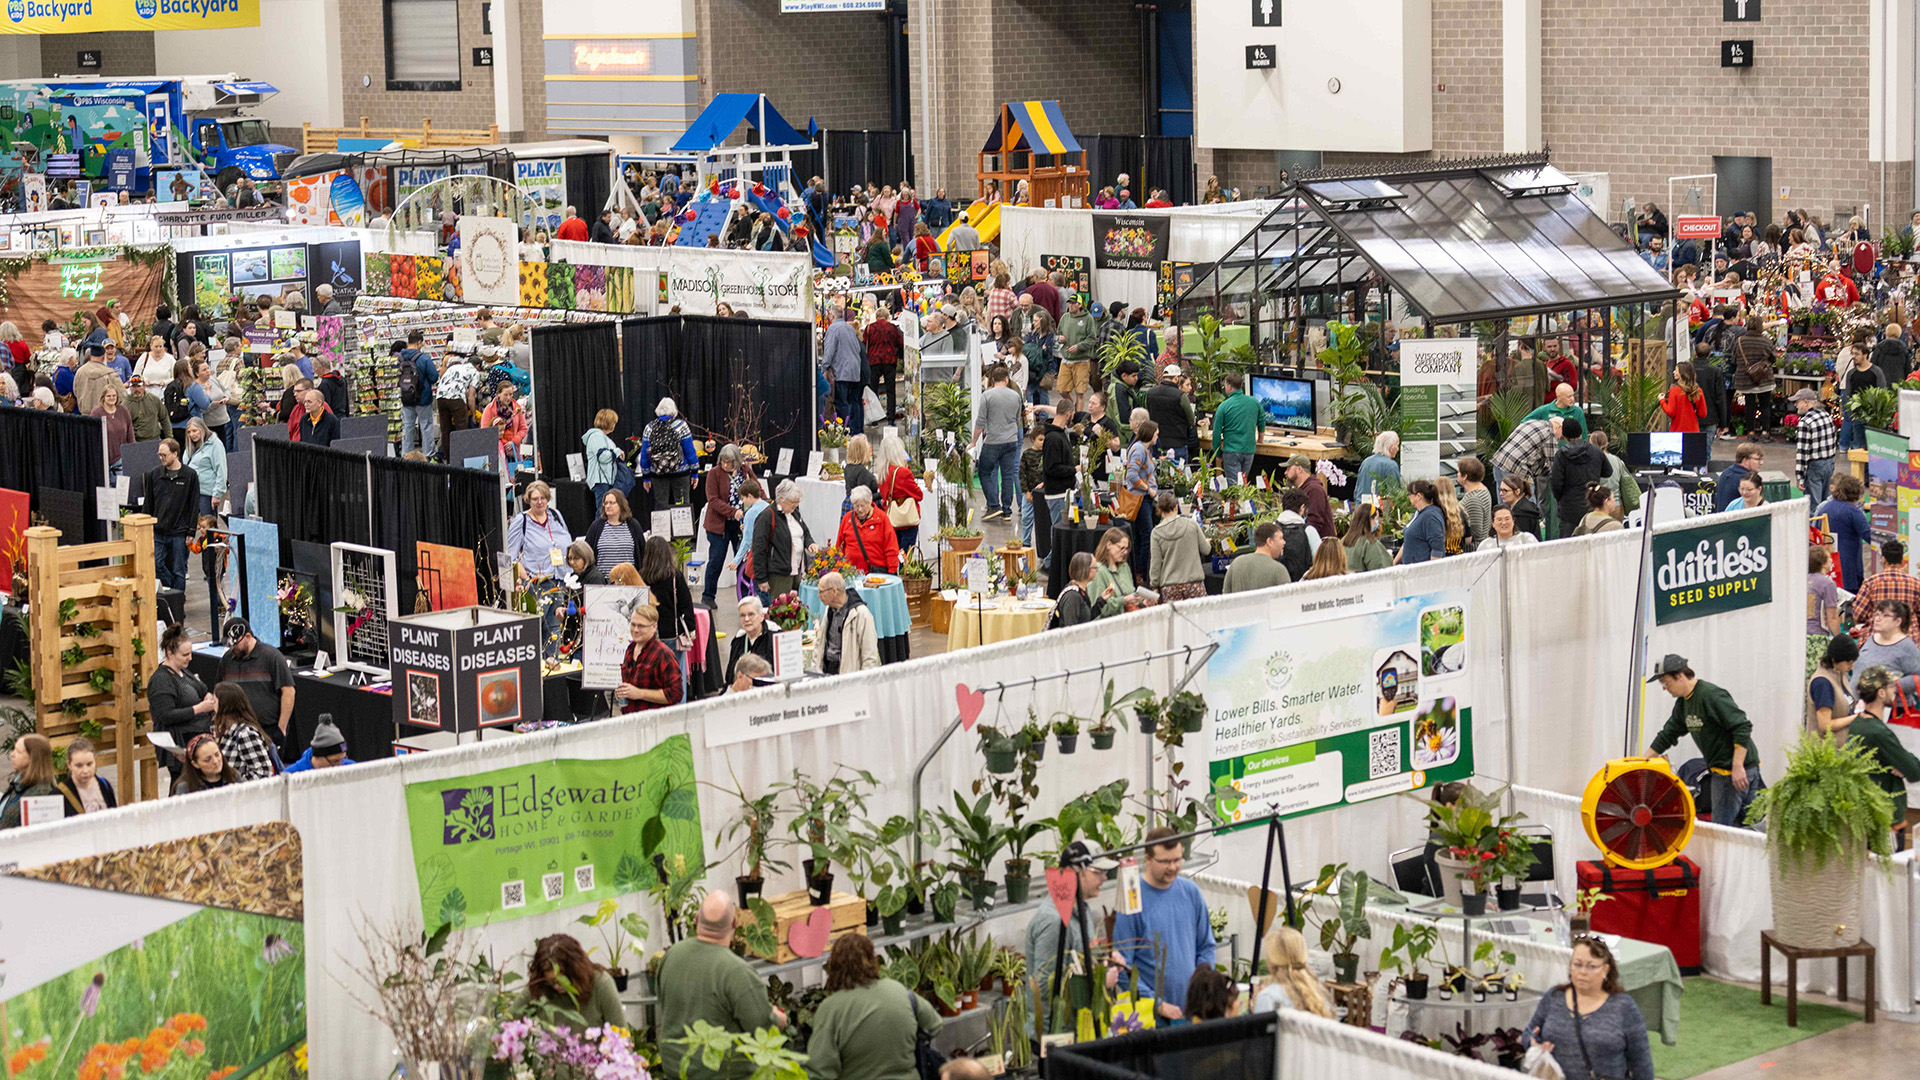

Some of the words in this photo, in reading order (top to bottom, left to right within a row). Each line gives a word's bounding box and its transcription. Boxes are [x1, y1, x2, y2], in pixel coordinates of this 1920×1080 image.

[27, 0, 92, 22] Backyard
[161, 0, 238, 18] Backyard
[81, 97, 92, 105] PBS
[94, 97, 125, 105] Wisconsin
[518, 177, 562, 187] WISCONSIN
[158, 212, 205, 223] CHARLOTTE
[210, 212, 232, 222] FUNG
[236, 211, 267, 219] MILLER
[1114, 217, 1145, 226] Wisconsin
[1682, 224, 1717, 232] CHECKOUT
[1106, 259, 1131, 270] Daylily
[1132, 260, 1153, 270] Society
[673, 279, 718, 293] MADISON
[721, 284, 764, 296] GREENHOUSE
[768, 284, 798, 296] STORE
[1415, 352, 1461, 360] WISCONSIN
[1415, 364, 1462, 373] COMPANY
[1657, 535, 1768, 591] driftless
[1670, 588, 1703, 607] SEED
[1708, 577, 1758, 599] SUPPLY
[401, 627, 439, 647] PLANT
[473, 625, 523, 647] PLANT
[393, 647, 450, 671] DISEASES
[461, 644, 536, 671] DISEASES
[1215, 706, 1250, 722] Lower
[1252, 700, 1278, 715] Bills.
[1282, 691, 1326, 709] Smarter
[1328, 683, 1363, 699] Water.
[749, 712, 781, 727] Edgewater
[783, 709, 799, 720] Home
[801, 706, 806, 717] &
[807, 704, 829, 716] Garden
[1215, 721, 1266, 741] Healthier
[1269, 713, 1303, 729] Yards.
[1215, 742, 1239, 755] Home
[1241, 737, 1269, 752] Energy
[1271, 734, 1276, 744] &
[1278, 725, 1328, 741] Sustainability
[1330, 717, 1362, 732] Services
[1247, 761, 1261, 771] Our
[1262, 755, 1290, 768] Services
[1243, 781, 1261, 789] Energy
[1262, 790, 1280, 799] Barrels
[1298, 781, 1320, 790] Gardens
[499, 773, 645, 819] Edgewater
[500, 819, 548, 838] HOME
[571, 806, 642, 824] GARDEN
